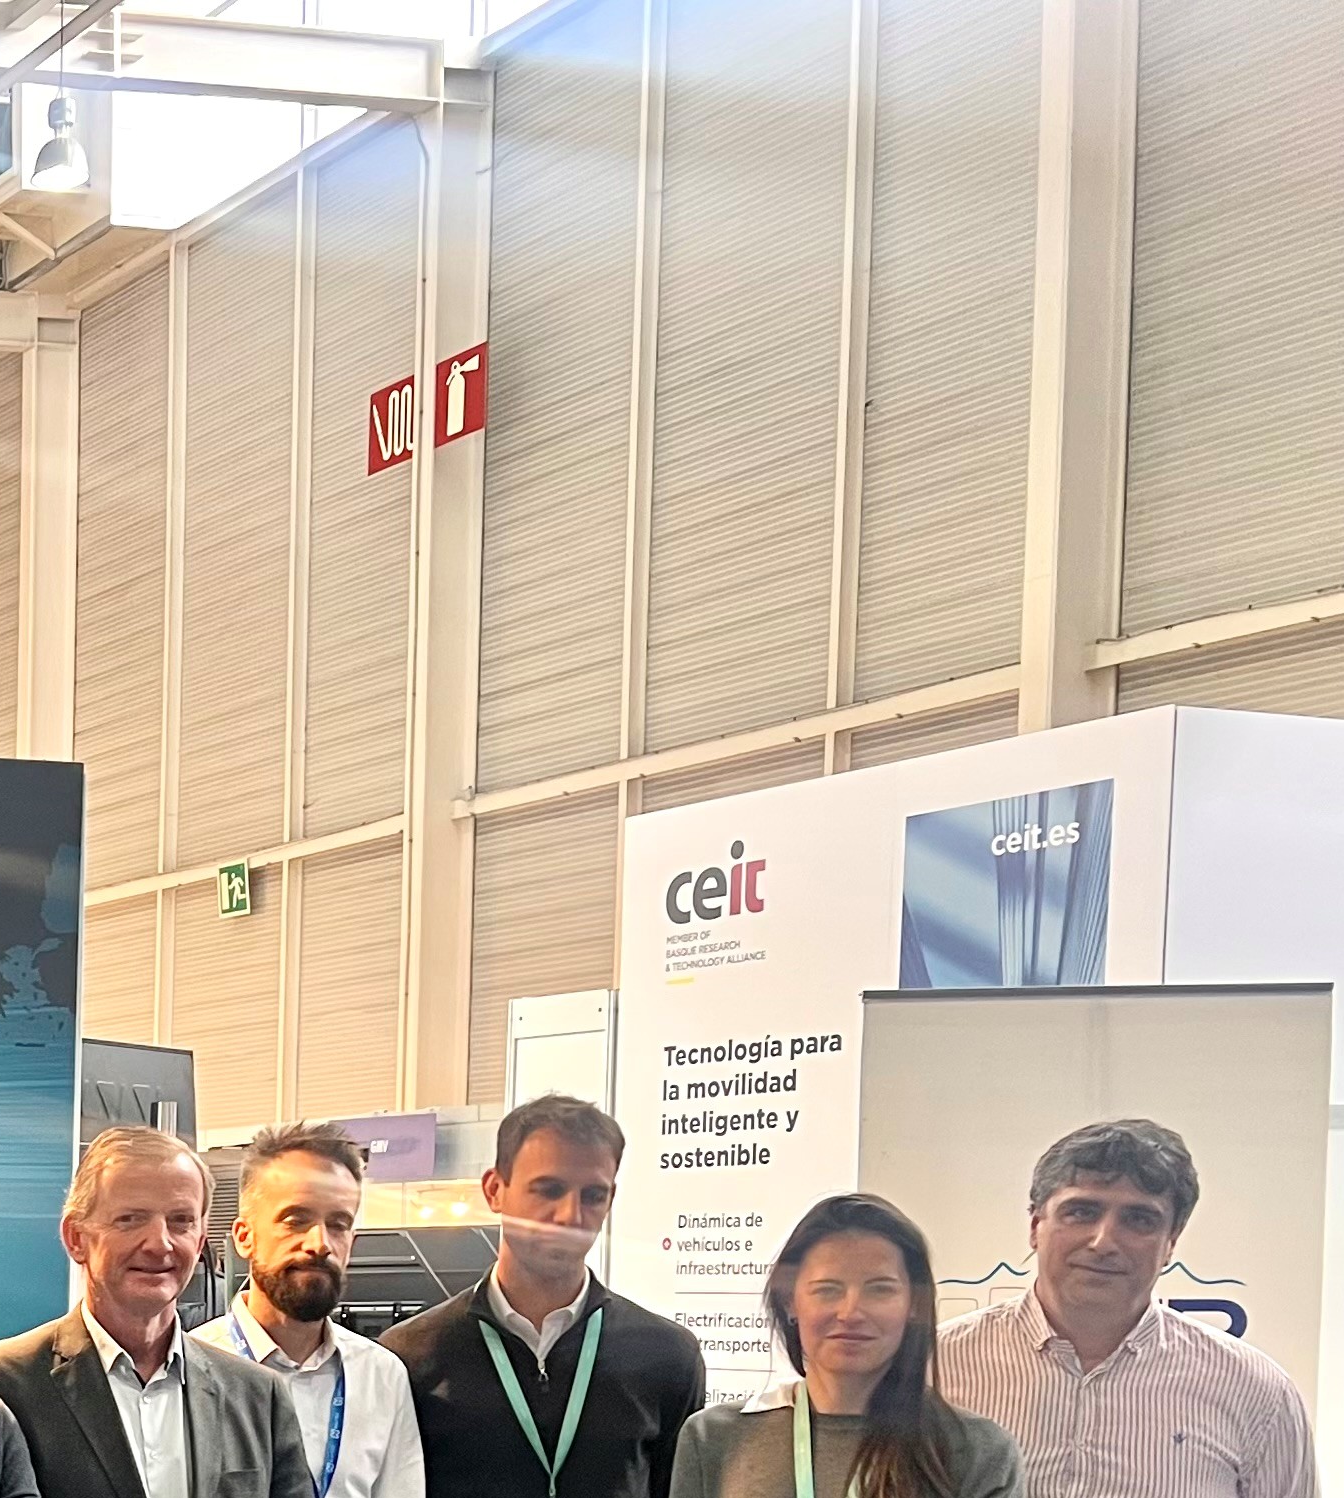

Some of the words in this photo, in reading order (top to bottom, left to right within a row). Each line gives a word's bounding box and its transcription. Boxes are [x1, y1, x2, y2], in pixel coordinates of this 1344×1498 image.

[991, 822, 1080, 856] ceit.es
[666, 840, 766, 924] ceit
[666, 932, 698, 945] MEMBER
[700, 930, 711, 941] OF
[666, 946, 697, 959] BASQUE
[698, 940, 741, 954] RESEARCH
[672, 955, 724, 971] TECHNOLOGY
[726, 951, 766, 964] ALLIANCE
[664, 1035, 782, 1066] Tecnología
[790, 1034, 842, 1060] para
[663, 1080, 679, 1101] la
[687, 1069, 797, 1099] movilidad
[661, 1109, 778, 1136] inteligente
[786, 1110, 799, 1132] y
[660, 1143, 770, 1169] sostenible
[678, 1212, 741, 1228] Dinámica
[745, 1212, 763, 1227] de
[677, 1237, 740, 1251] vehículos
[745, 1240, 753, 1251] e
[699, 1338, 771, 1354] transporte
